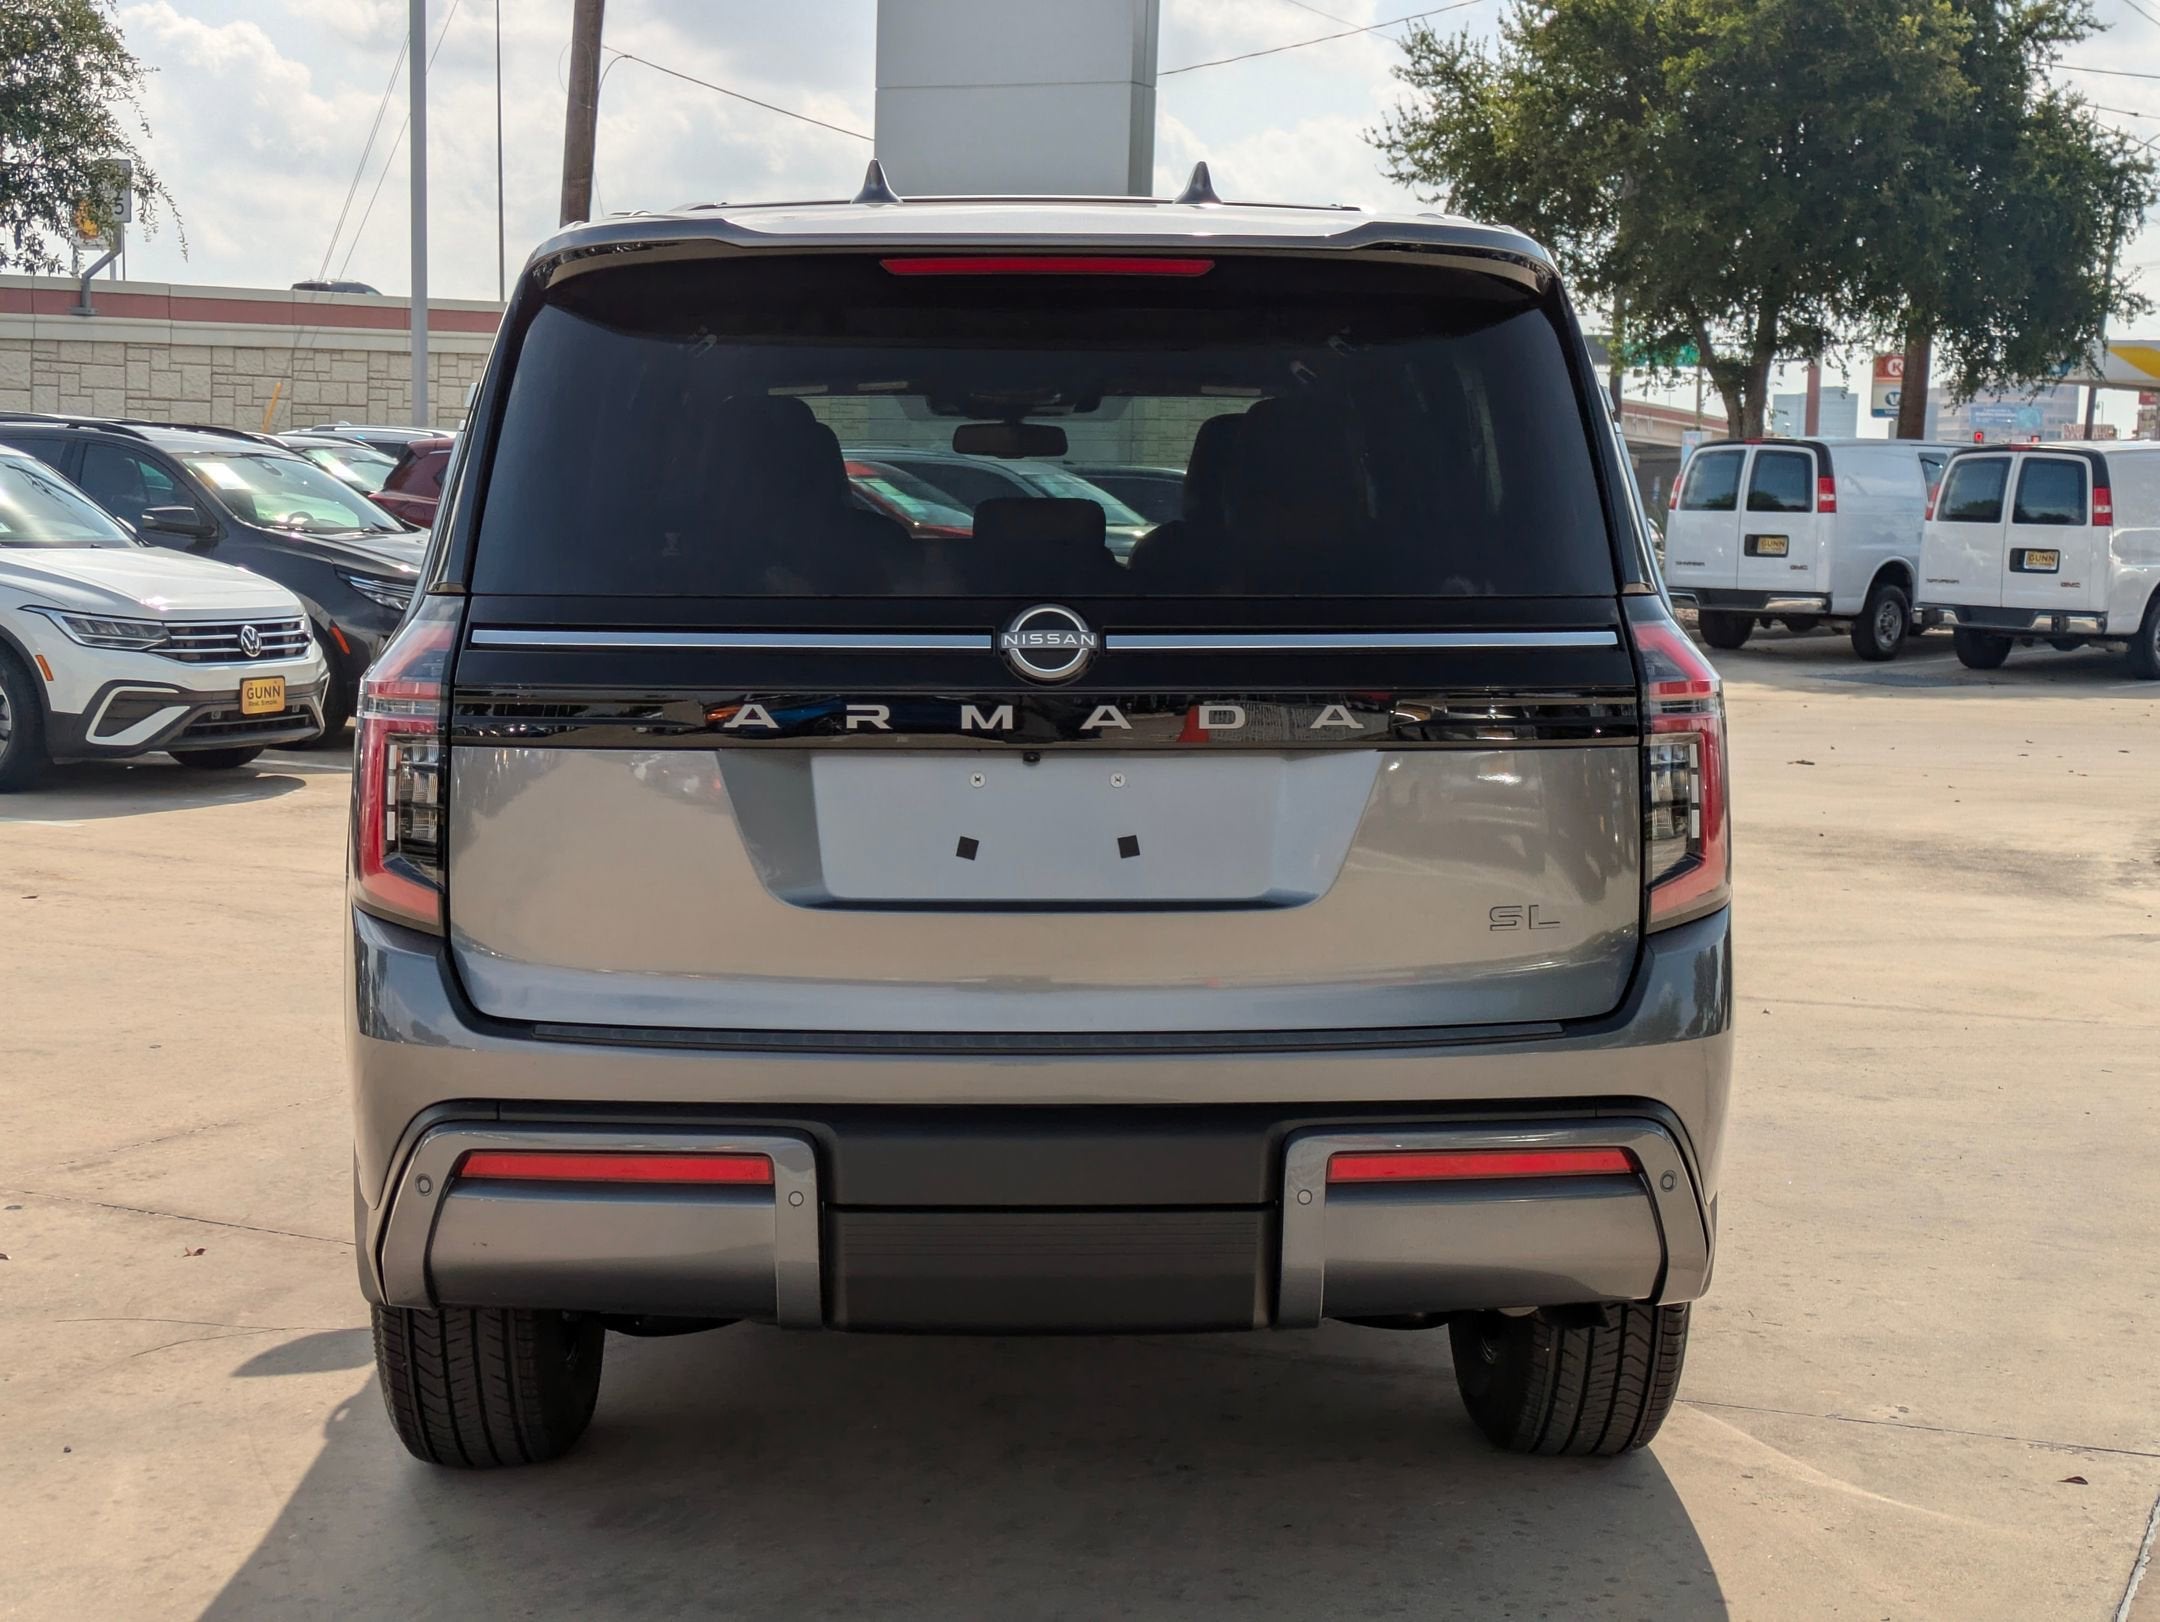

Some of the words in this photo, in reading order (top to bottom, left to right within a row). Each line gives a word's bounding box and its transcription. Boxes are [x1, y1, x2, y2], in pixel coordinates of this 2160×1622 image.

[1761, 538, 1785, 548] GUNN
[2028, 553, 2055, 563] GUNN
[1004, 633, 1095, 646] NISSAN
[246, 685, 281, 700] GUNN
[722, 704, 1364, 730] ARMADA
[1489, 904, 1561, 931] SL
